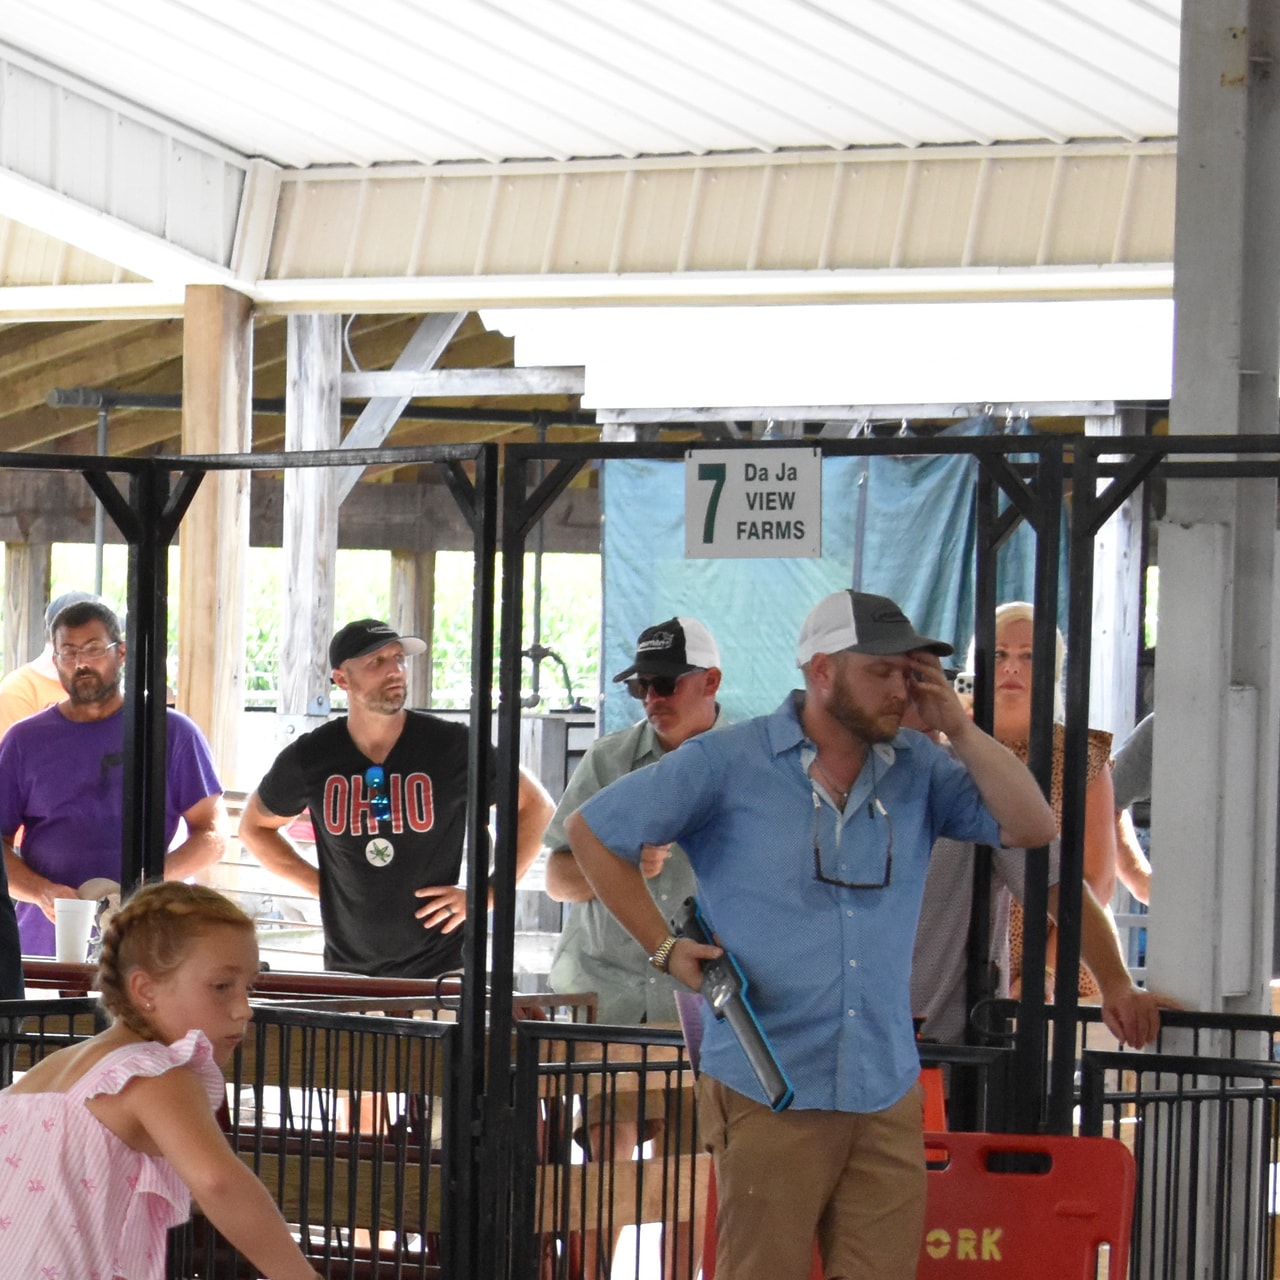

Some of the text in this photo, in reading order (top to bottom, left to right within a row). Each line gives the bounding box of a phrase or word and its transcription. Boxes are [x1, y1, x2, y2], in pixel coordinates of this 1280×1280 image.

[744, 462, 797, 482] Da Ja
[697, 462, 727, 544] 7
[745, 491, 796, 511] VIEW
[736, 520, 805, 540] FARMS
[323, 772, 434, 836] OHIO
[926, 1228, 1003, 1261] ORK
